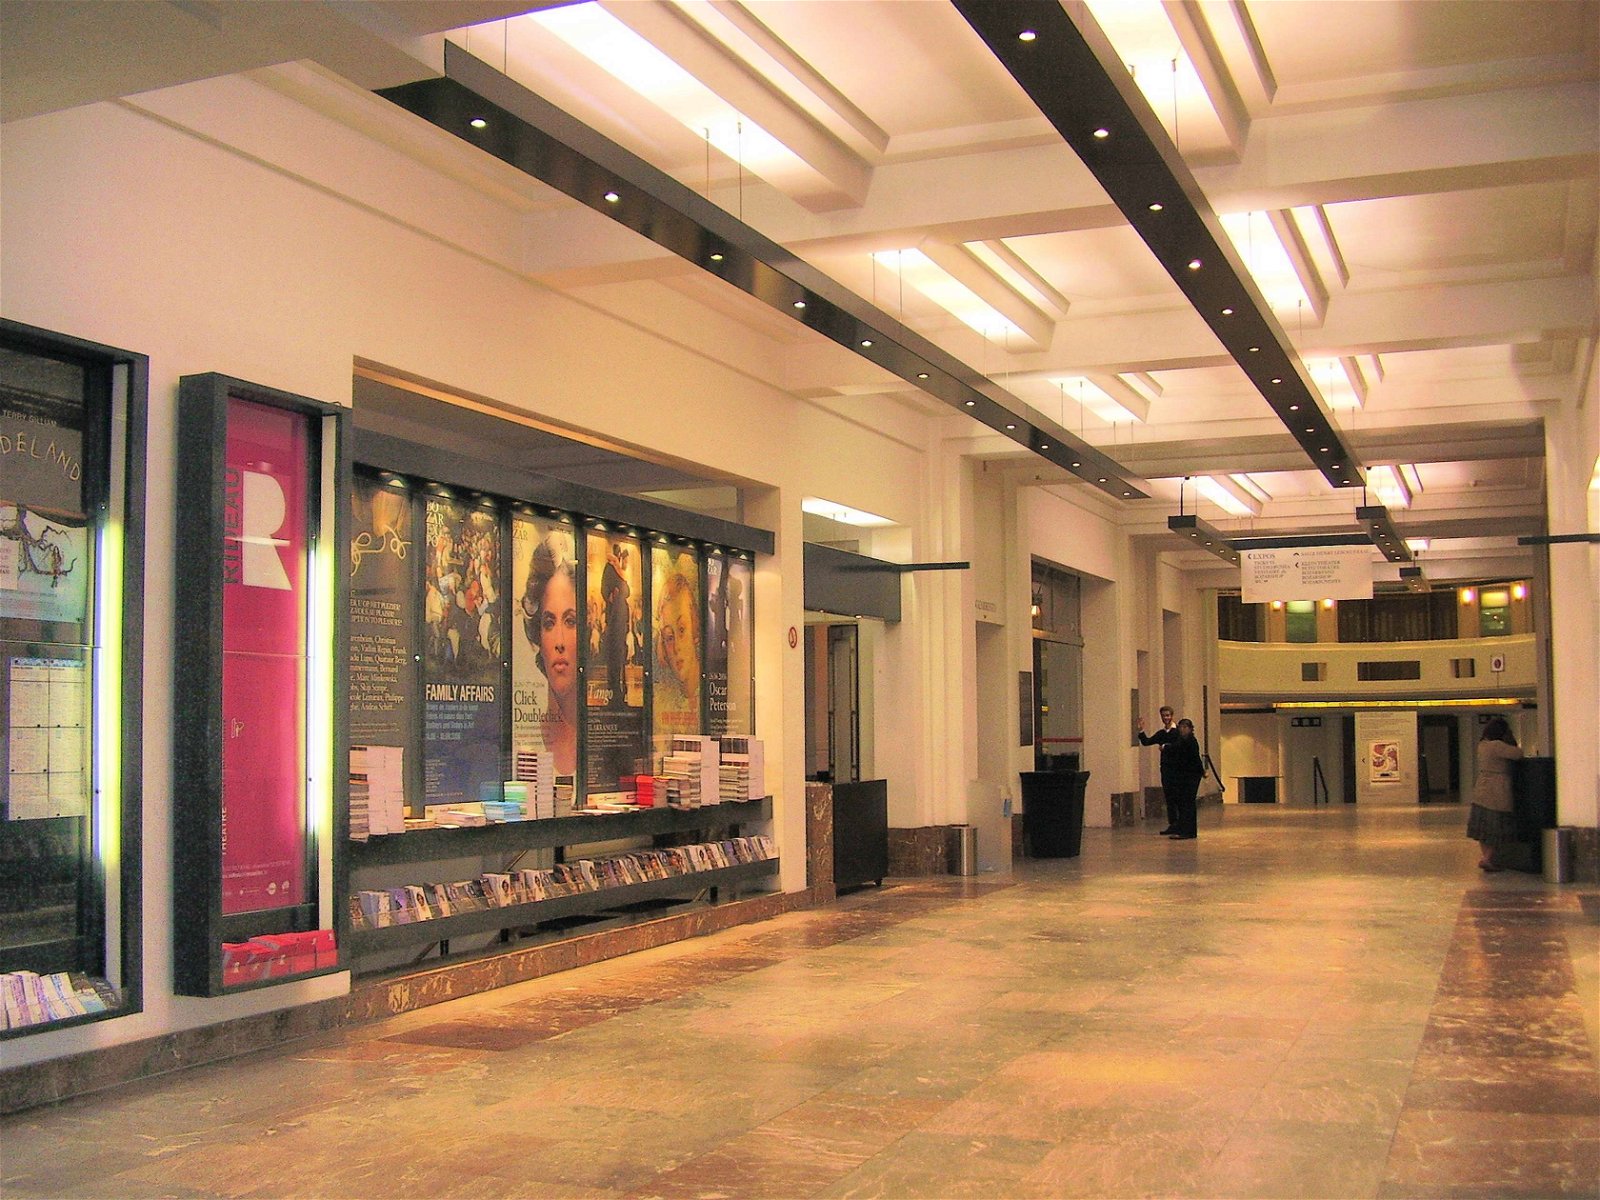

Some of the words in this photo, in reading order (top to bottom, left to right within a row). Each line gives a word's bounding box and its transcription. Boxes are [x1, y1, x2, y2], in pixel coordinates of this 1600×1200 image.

[223, 467, 241, 585] RIDEAU
[242, 470, 292, 591] R
[425, 684, 458, 701] FAMILY
[460, 685, 495, 702] AFFAIRS
[514, 690, 538, 705] Click
[587, 683, 614, 705] Tango
[709, 682, 728, 696] Oscar
[709, 697, 737, 711] Peterson
